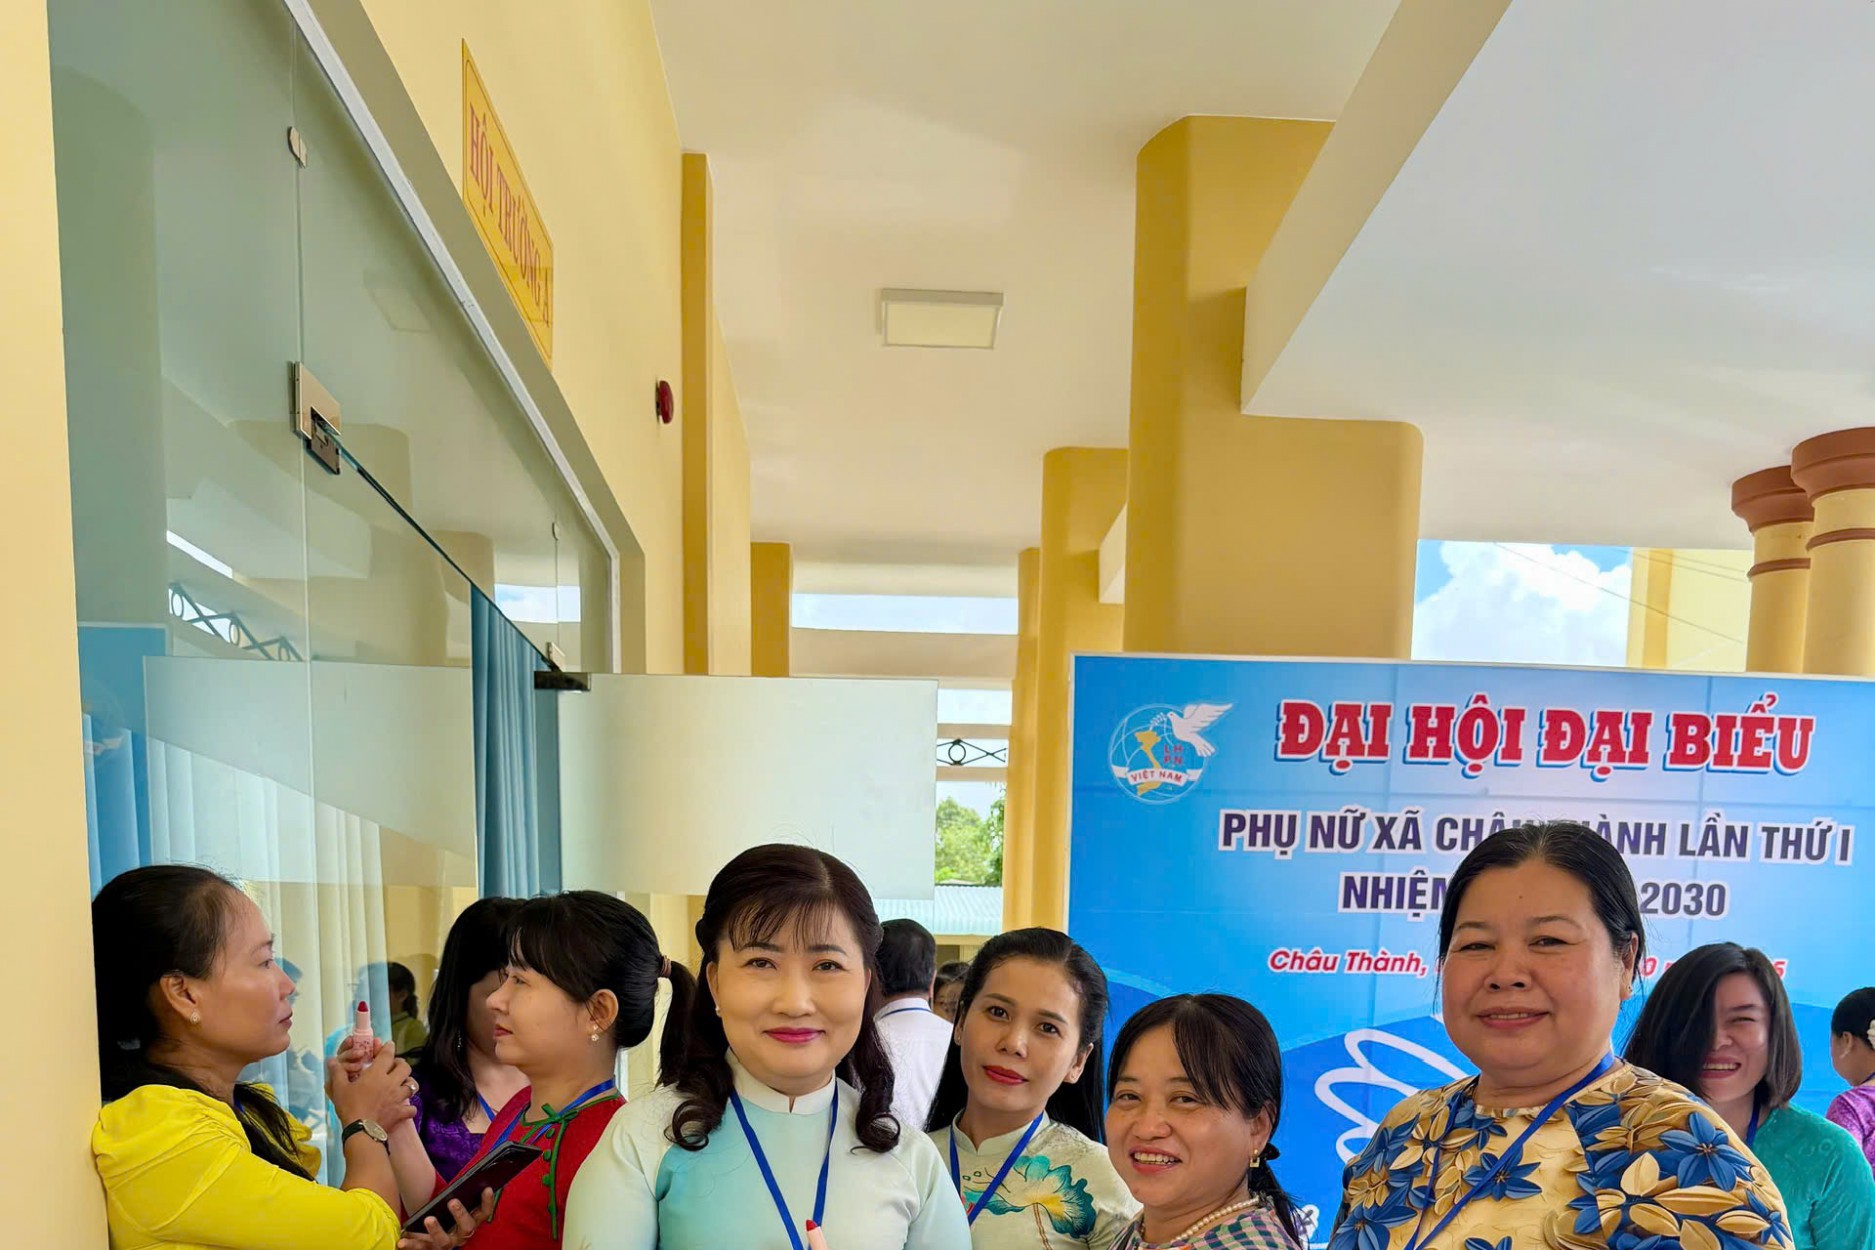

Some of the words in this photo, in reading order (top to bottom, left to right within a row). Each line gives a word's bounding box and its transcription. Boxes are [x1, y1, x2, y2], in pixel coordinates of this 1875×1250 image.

[469, 101, 494, 218] HỘI
[1277, 701, 1393, 771] ĐẠI
[1407, 693, 1527, 774] HỘI
[1541, 708, 1653, 777] ĐẠI
[1667, 693, 1815, 771] BIỂU
[1159, 770, 1183, 783] NAM
[1222, 813, 1298, 856] PHỤ
[1308, 808, 1367, 850] NỮ
[1372, 809, 1423, 850] XÃ
[1435, 811, 1533, 852] CHÂ
[1552, 814, 1668, 856] ÀNH
[1678, 811, 1749, 858] LẦN
[1760, 820, 1833, 862] THỨ
[1838, 828, 1852, 862] I
[1639, 881, 1727, 917] 2030
[1269, 949, 1339, 972] Châu
[1346, 951, 1427, 976] Thành,
